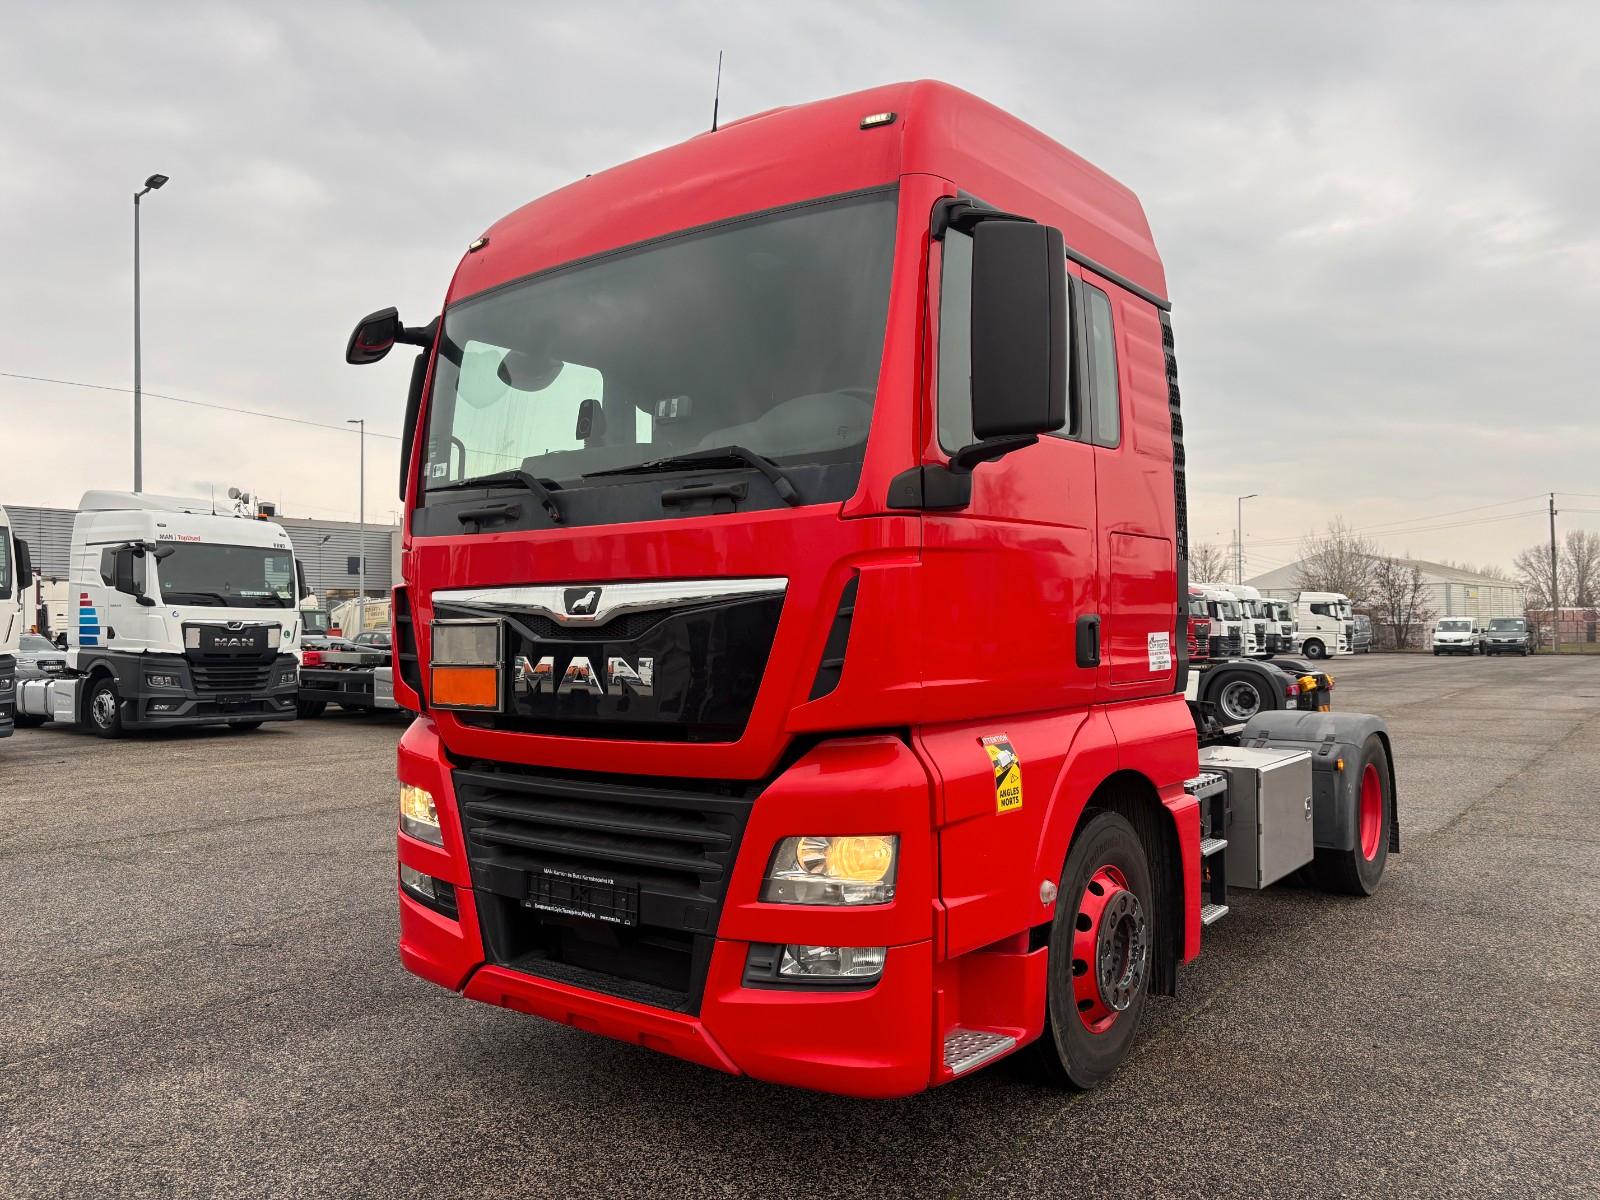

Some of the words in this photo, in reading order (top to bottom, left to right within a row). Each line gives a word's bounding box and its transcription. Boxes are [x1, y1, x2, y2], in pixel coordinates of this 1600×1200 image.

[214, 637, 254, 647] MAN
[514, 656, 654, 696] MAN
[1000, 787, 1019, 798] ANGLES
[1001, 796, 1019, 807] MORTS
